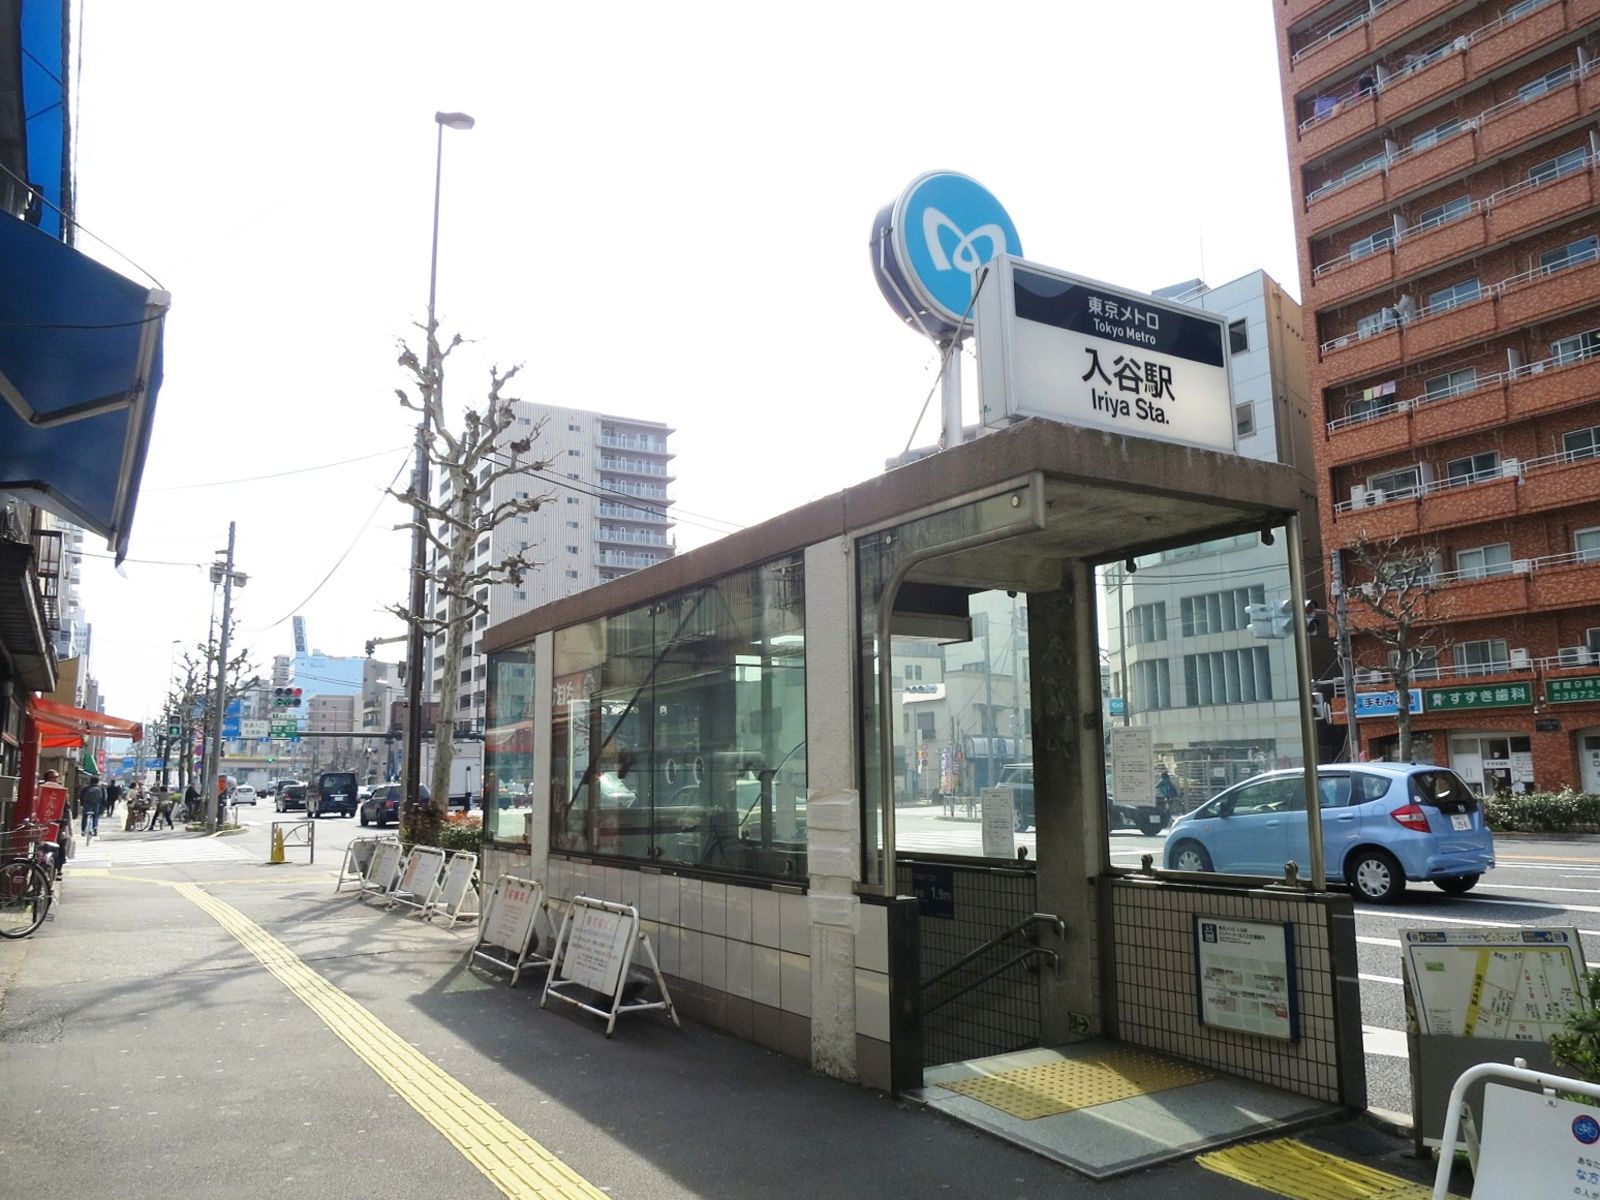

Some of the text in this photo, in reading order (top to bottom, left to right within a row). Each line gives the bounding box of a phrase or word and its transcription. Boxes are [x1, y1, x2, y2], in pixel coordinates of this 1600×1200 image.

[1087, 295, 1160, 331] 東京メトロ
[1092, 317, 1156, 345] Tokyo Metro
[1081, 347, 1175, 402] 入谷駅
[1091, 387, 1170, 425] Iriya Sta.
[1449, 687, 1526, 705] すずき歯科
